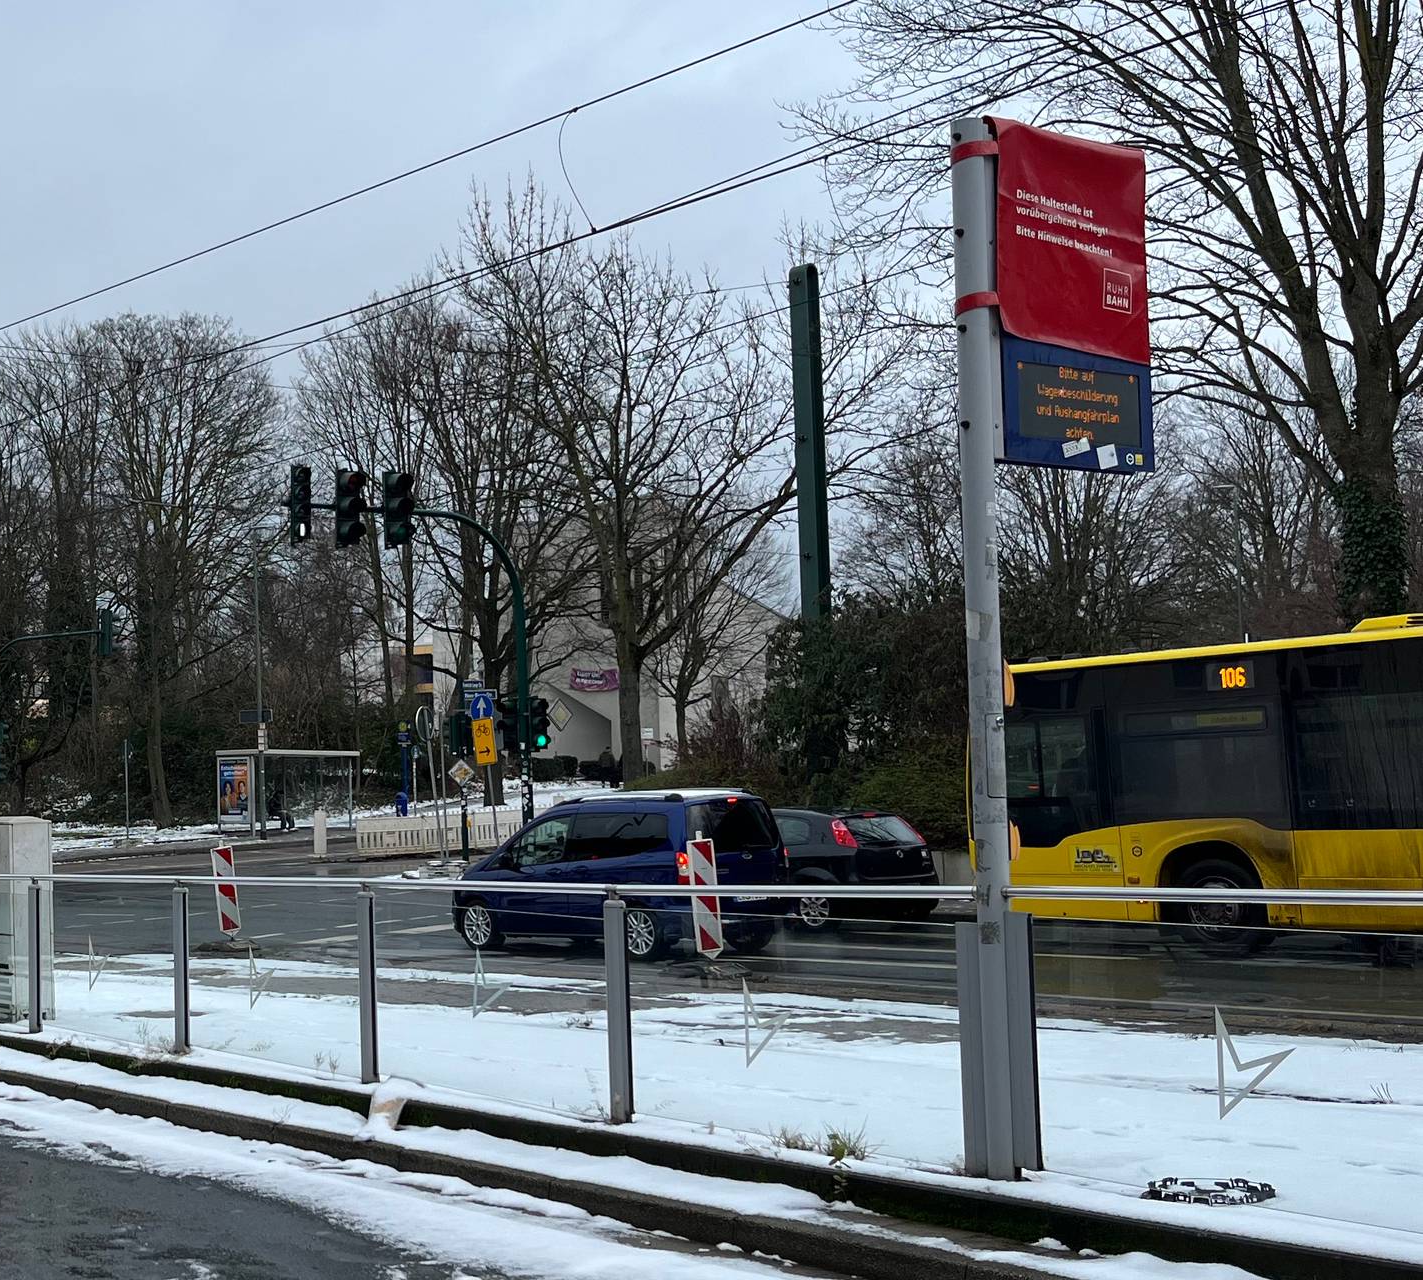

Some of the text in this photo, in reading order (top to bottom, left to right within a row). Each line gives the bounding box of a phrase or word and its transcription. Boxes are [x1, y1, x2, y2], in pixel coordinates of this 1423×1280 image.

[1016, 189, 1094, 219] Diese Haltestelle ist
[1016, 206, 1077, 228] vorübergehend
[1016, 225, 1113, 258] Bitte Hinweise beachten!
[1106, 282, 1129, 297] RUHR
[1106, 294, 1129, 309] BAHN
[1058, 366, 1095, 384] Bitte auf
[1037, 405, 1052, 417] und
[1219, 666, 1246, 689] 106
